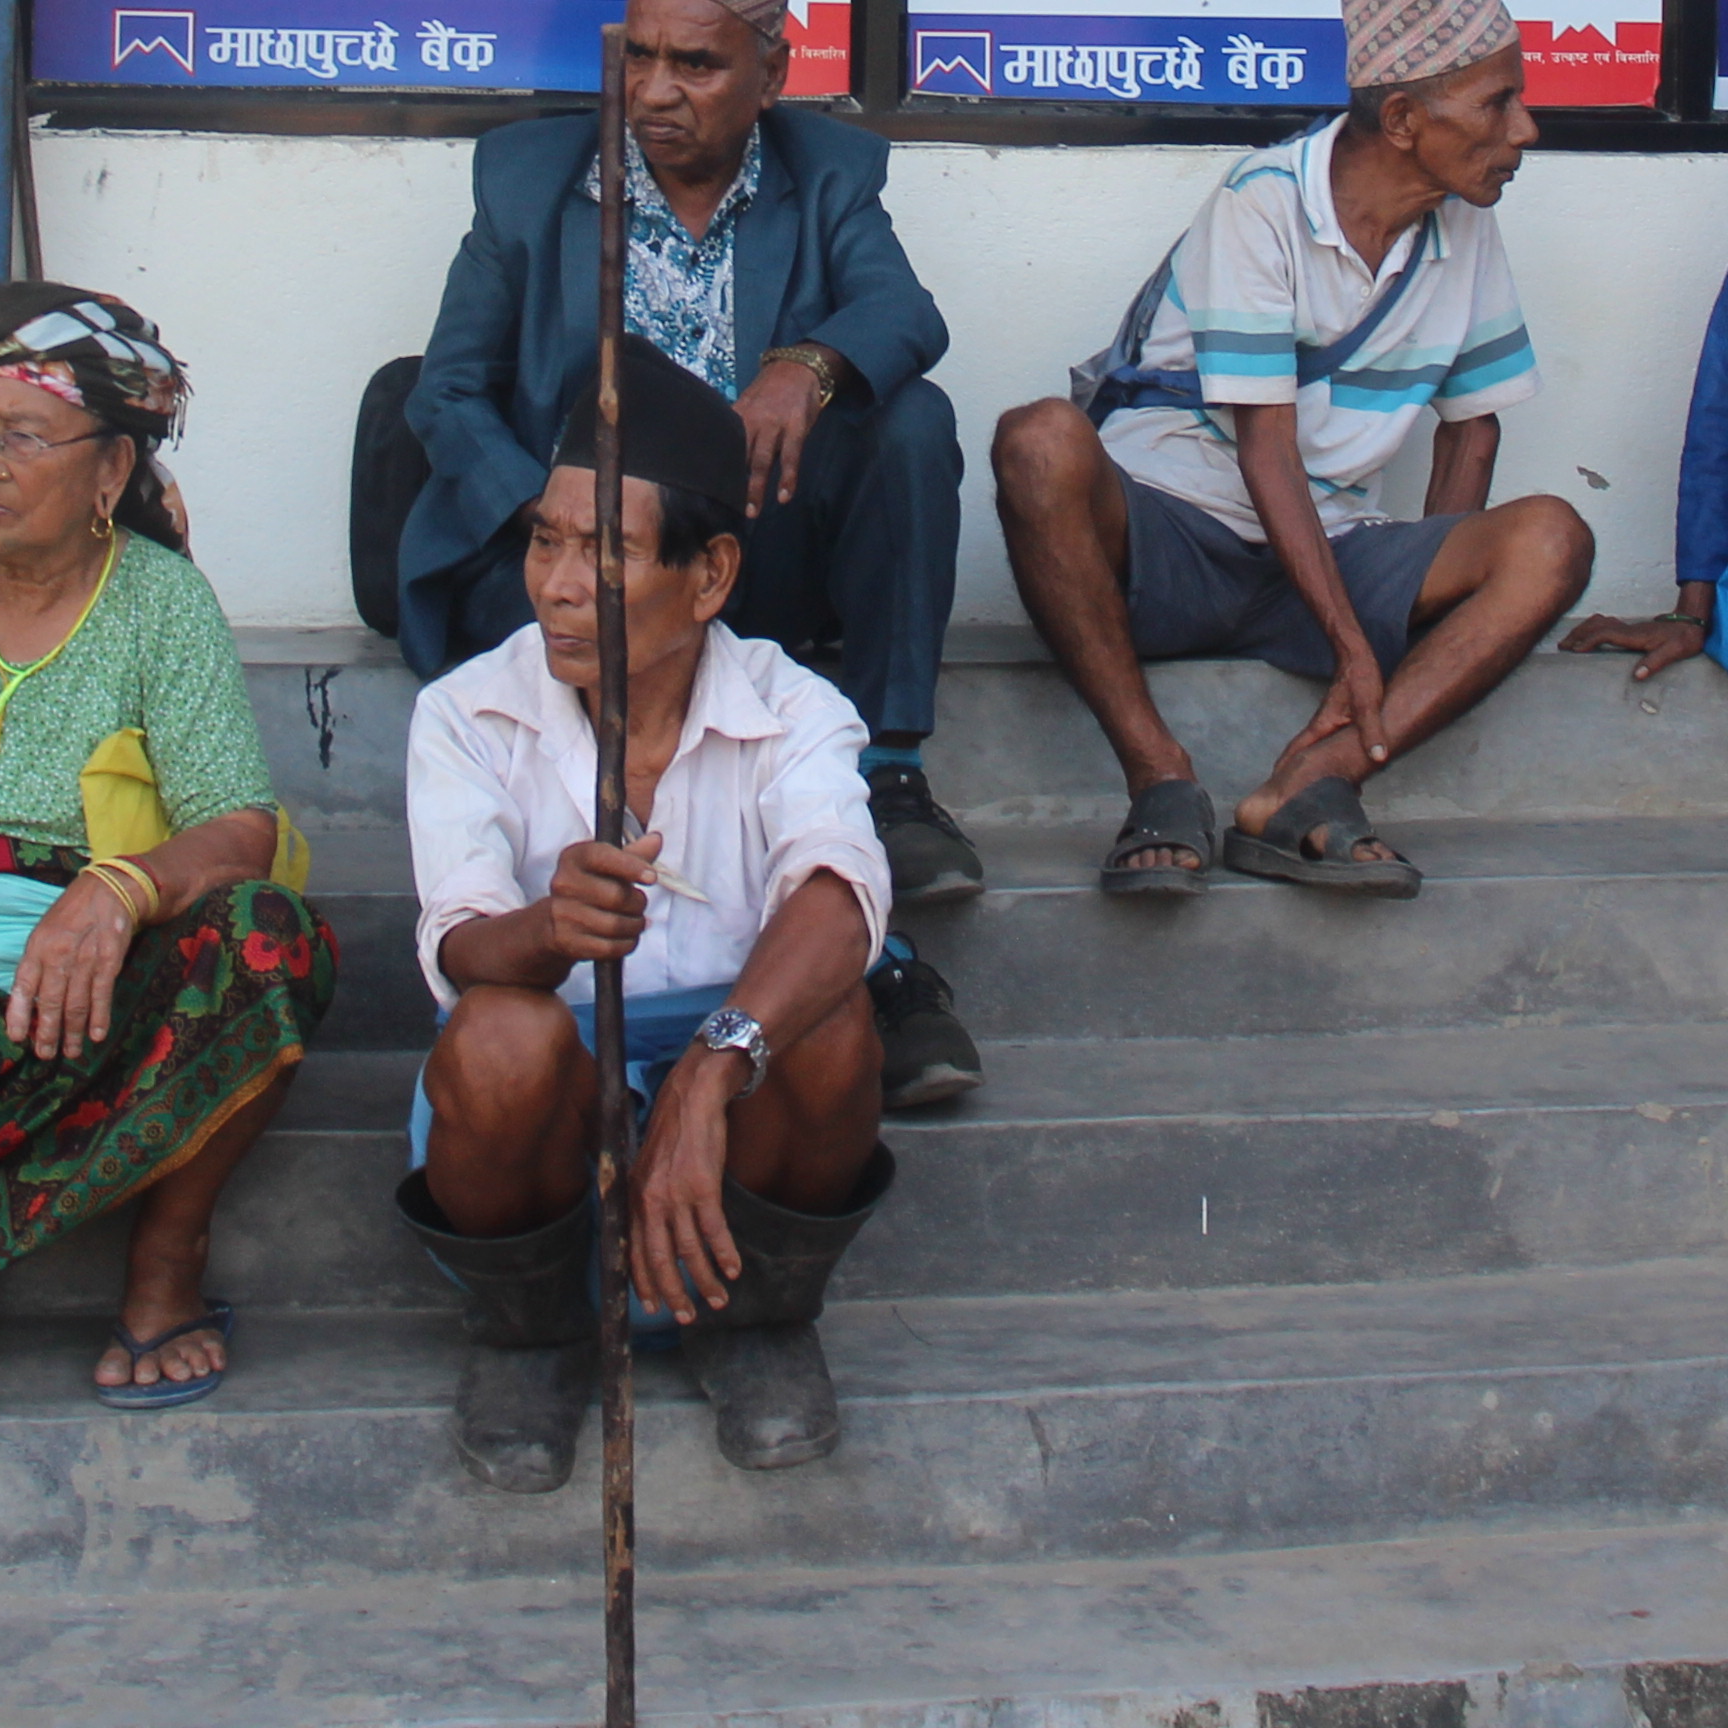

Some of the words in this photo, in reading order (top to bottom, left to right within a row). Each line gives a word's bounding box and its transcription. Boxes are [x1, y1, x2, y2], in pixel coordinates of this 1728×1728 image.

[205, 21, 399, 77] माछापुच्छ्रे
[417, 20, 496, 72] बैंक
[1000, 36, 1205, 97] माछापुच्छ्रे
[1223, 35, 1307, 90] बैंक
